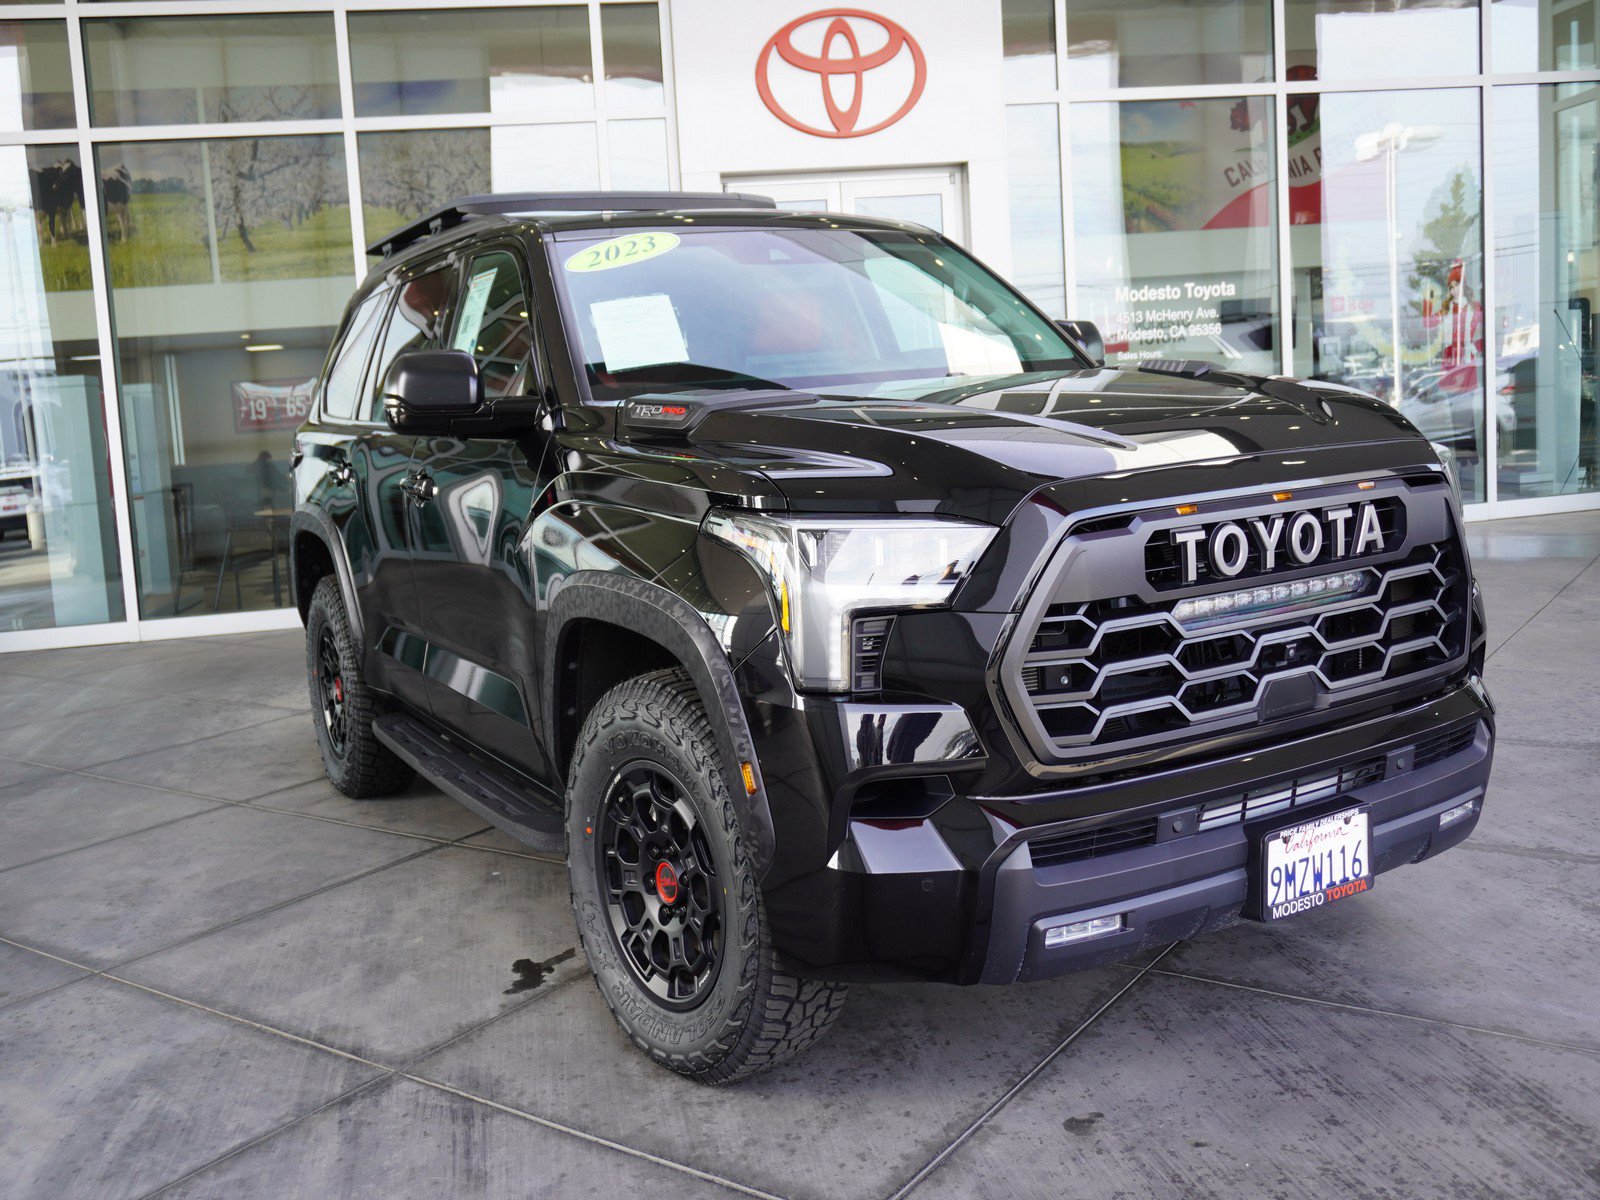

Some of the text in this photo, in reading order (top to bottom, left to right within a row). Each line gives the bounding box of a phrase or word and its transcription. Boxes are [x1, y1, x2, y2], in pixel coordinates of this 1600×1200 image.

[587, 235, 656, 268] 2023
[1115, 281, 1236, 302] Modesto Toyota
[1145, 308, 1194, 322] McHenry
[1195, 306, 1219, 319] Ave.
[1117, 322, 1222, 341] Modesto, CA 95356
[1117, 350, 1164, 361] Sales Hours:
[661, 406, 686, 415] PRO
[1172, 502, 1385, 583] TOYOTA
[1285, 826, 1349, 854] California
[1271, 839, 1362, 907] 9MZW116
[1272, 879, 1367, 919] MODESTO TOYOTA
